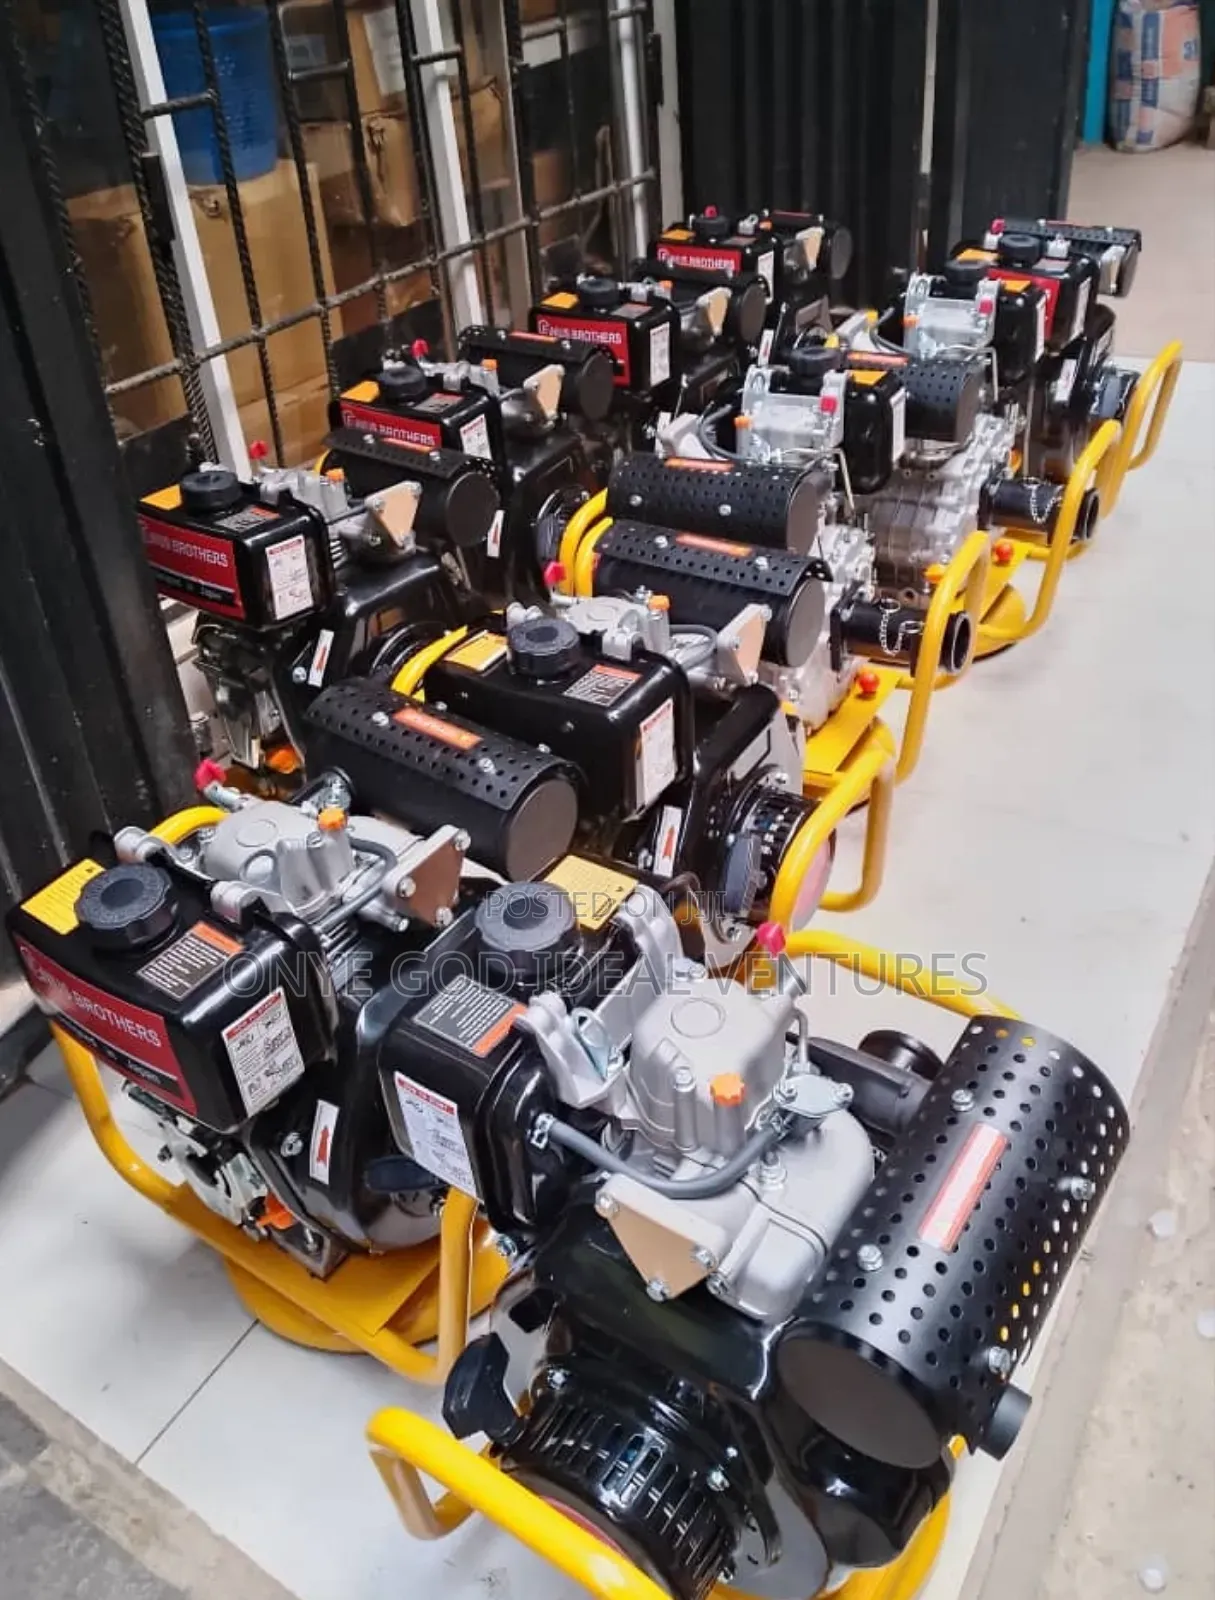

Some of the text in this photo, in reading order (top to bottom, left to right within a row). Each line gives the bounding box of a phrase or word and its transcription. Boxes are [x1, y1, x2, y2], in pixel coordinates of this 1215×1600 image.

[571, 329, 622, 344] BROTHERS
[379, 424, 436, 446] BROTHERS
[171, 539, 229, 567] BROTHERS
[72, 989, 162, 1047] BROTHERS
